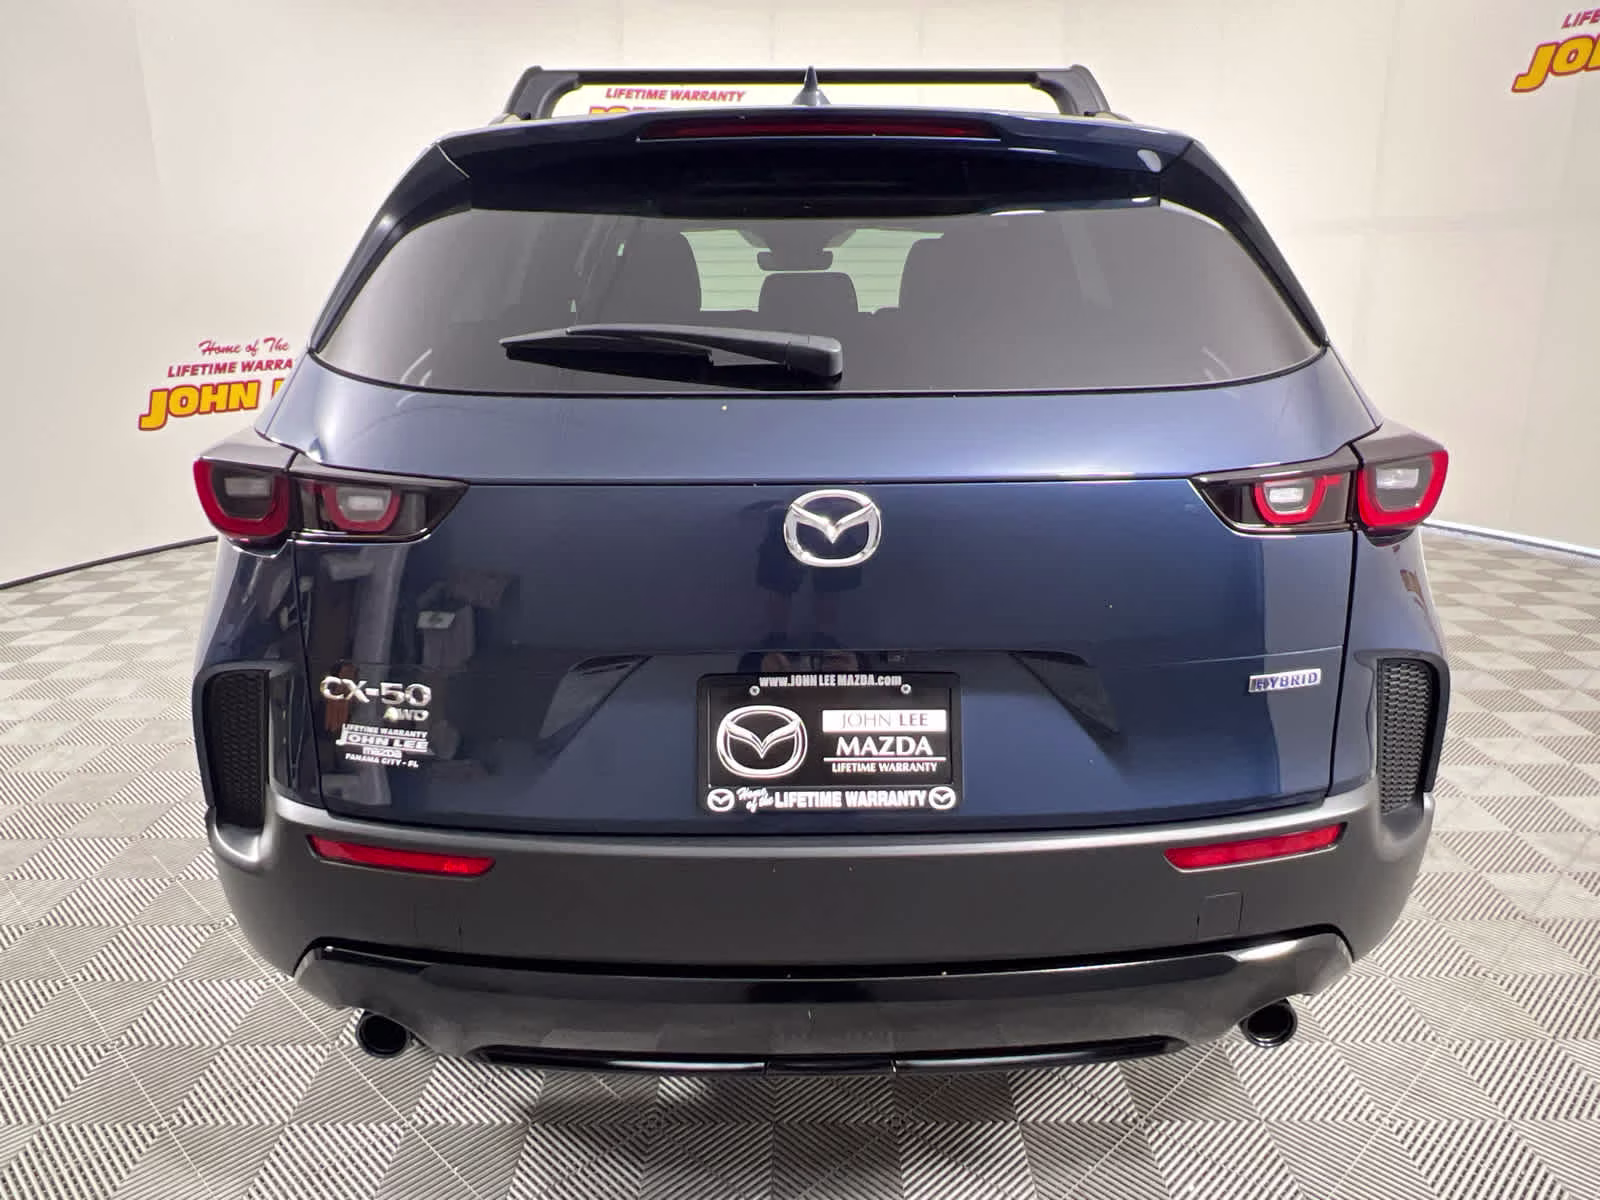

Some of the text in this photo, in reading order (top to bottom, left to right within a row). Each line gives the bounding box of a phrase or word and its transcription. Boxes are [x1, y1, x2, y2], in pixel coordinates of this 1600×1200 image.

[605, 88, 746, 102] LIFETIME WARRANTY
[198, 337, 289, 356] Home of The
[167, 361, 237, 377] LIFETIME
[138, 379, 262, 431] JOHN
[819, 675, 836, 687] LEE
[837, 674, 903, 686] MAZDA.com
[1256, 672, 1318, 689] HYBRID
[320, 676, 432, 706] CX-50
[841, 713, 928, 728] JOHN LEE
[342, 723, 428, 738] LIFETIME WARRANTY
[335, 731, 429, 750] JOHN LEE
[836, 736, 934, 756] MAZDA
[345, 753, 380, 763] PANAMA
[381, 757, 402, 766] CITY
[407, 760, 419, 768] FL
[832, 762, 938, 773] LIFETIME WARRANTY
[774, 790, 928, 808] LIFETIME WARRANTY
